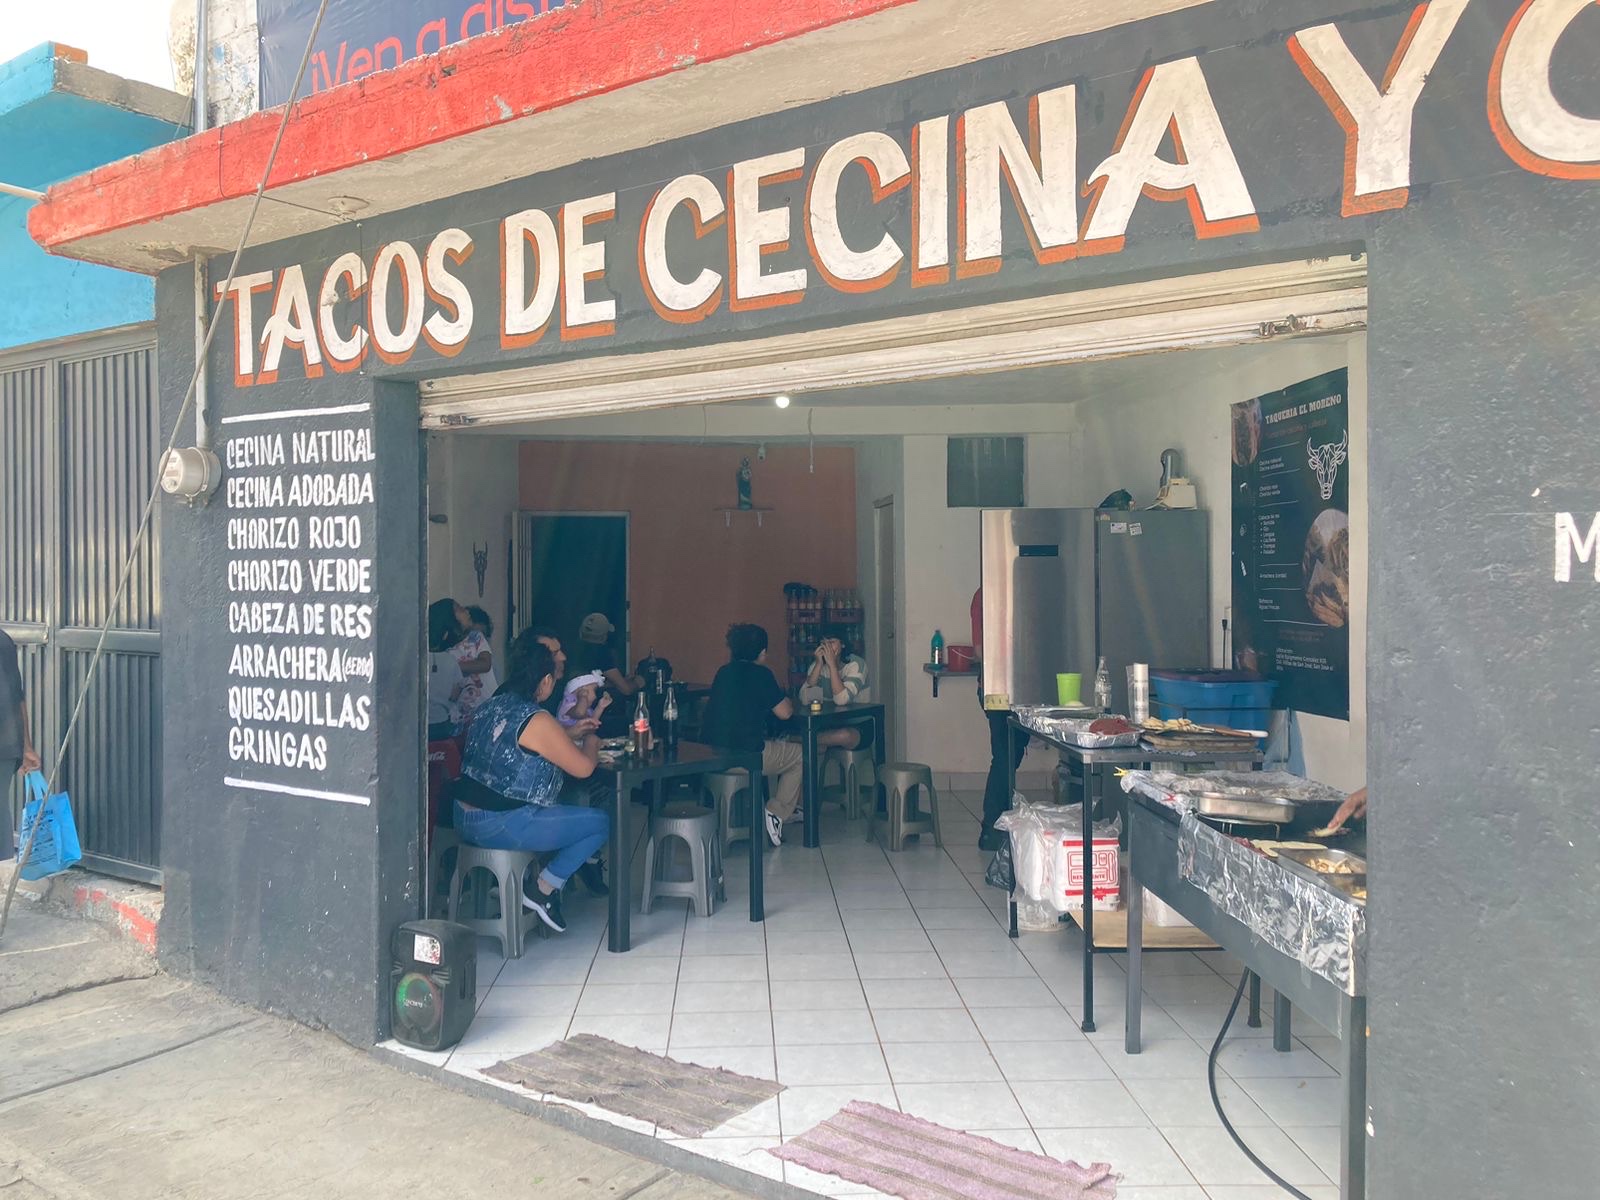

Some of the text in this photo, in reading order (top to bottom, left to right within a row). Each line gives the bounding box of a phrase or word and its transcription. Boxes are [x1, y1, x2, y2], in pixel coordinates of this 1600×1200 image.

[214, 227, 475, 388] TACOS
[500, 191, 616, 350] DE
[638, 55, 1260, 323] CECINA
[1265, 394, 1342, 424] TAQUERIA EL MORENO
[227, 428, 376, 470] CECINA NATURAL
[227, 473, 375, 508] CECINA ADOBADA
[227, 515, 361, 549] CHORIZO ROJO
[227, 558, 372, 593] CHORIZO VERDE
[229, 601, 373, 639] CABEZA DE RES
[228, 686, 371, 731] QUESADILLAS
[228, 727, 328, 771] GRINGAS
